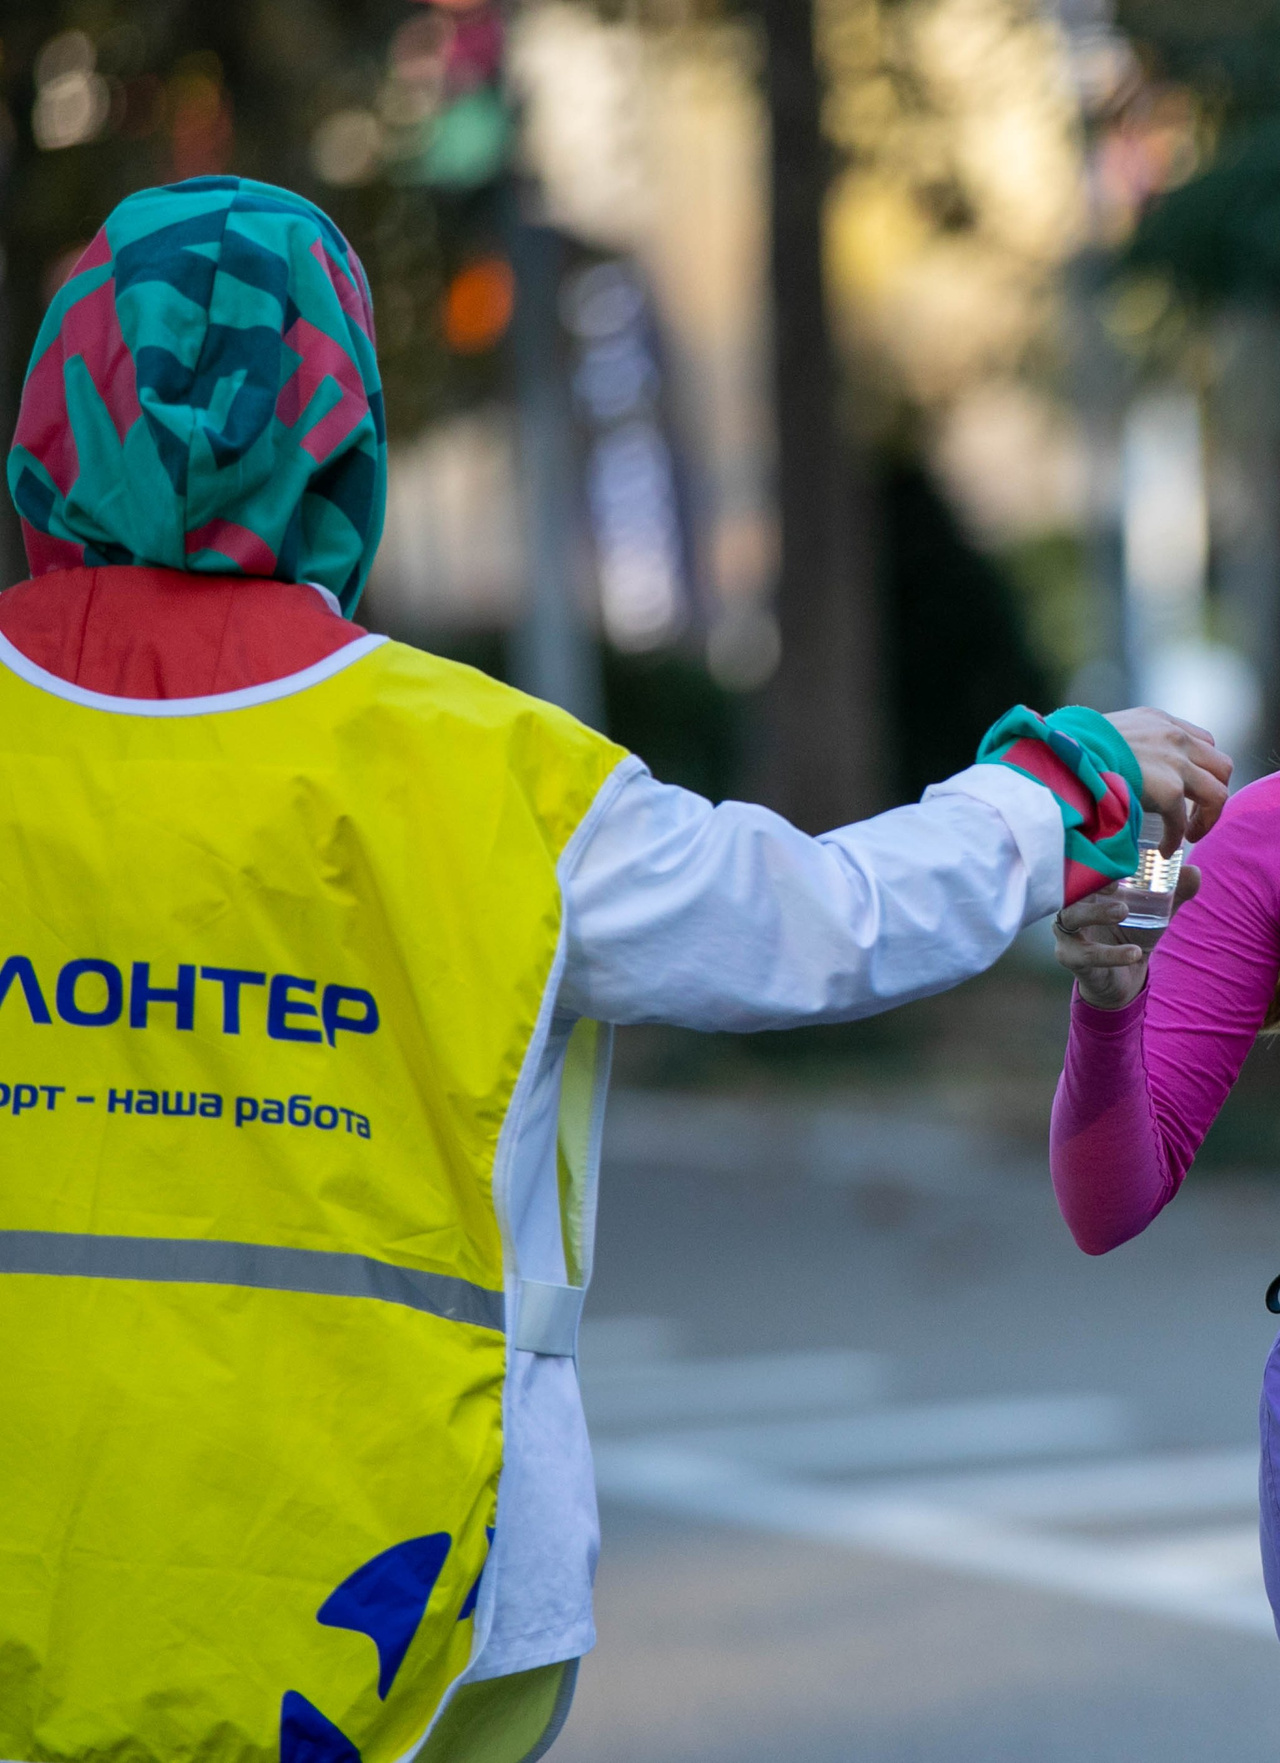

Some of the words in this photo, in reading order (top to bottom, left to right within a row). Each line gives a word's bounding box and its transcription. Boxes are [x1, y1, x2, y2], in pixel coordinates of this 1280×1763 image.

[0, 955, 379, 1048] ЛОНТЕР
[107, 1088, 223, 1118] наша
[235, 1094, 371, 1139] работа
